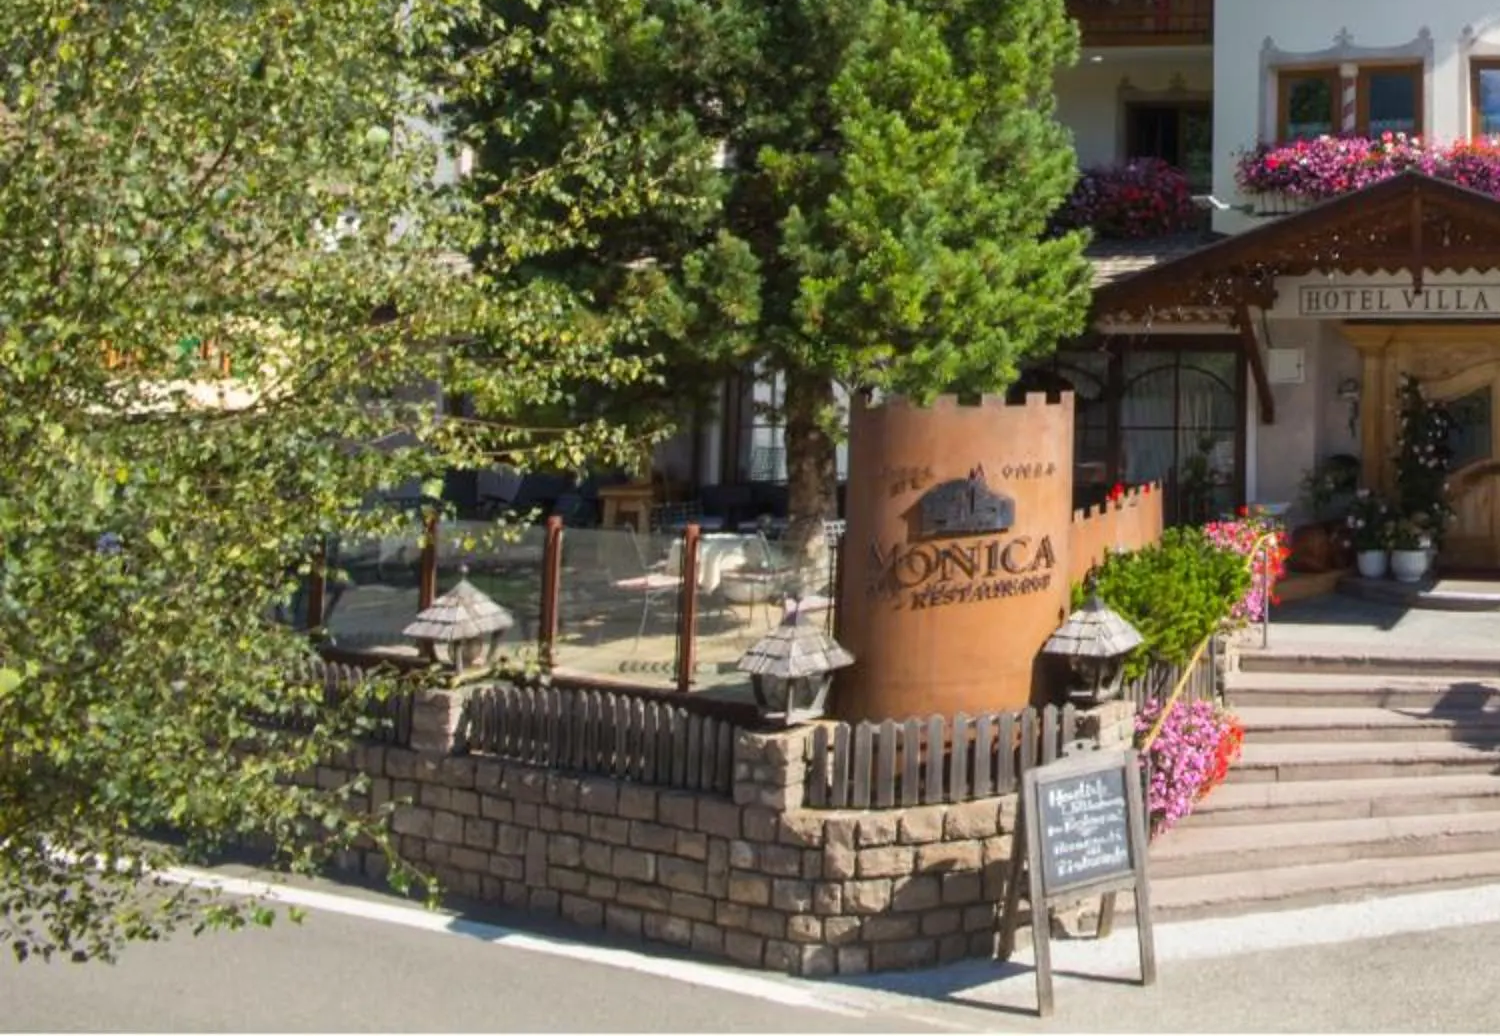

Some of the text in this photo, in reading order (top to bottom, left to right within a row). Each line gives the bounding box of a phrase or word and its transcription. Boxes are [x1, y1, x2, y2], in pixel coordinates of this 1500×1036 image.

[1305, 289, 1390, 311] HOTEL
[1401, 288, 1489, 310] VILLA
[867, 534, 1057, 589] MONICA
